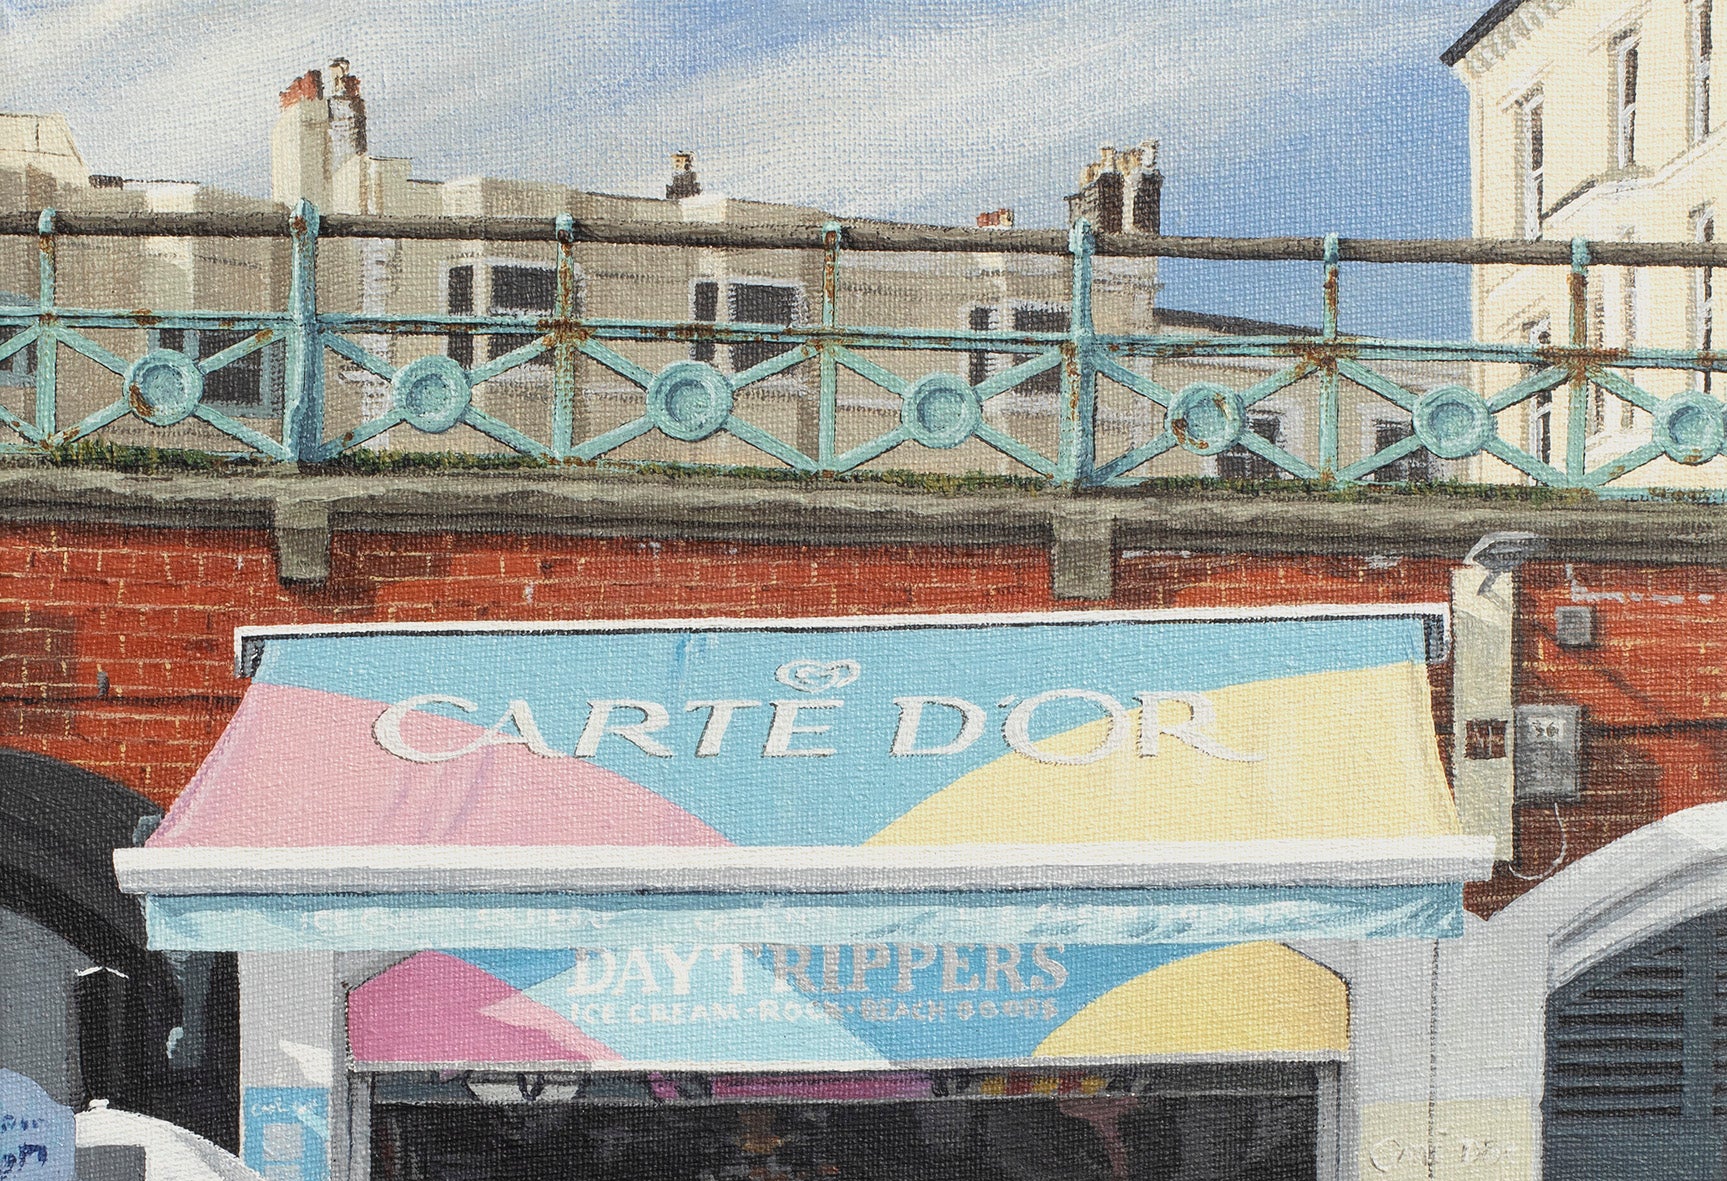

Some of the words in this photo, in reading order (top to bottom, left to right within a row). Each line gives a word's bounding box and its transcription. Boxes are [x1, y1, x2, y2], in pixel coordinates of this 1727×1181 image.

[372, 693, 846, 764] CARTE
[889, 687, 1265, 764] D'OR
[571, 1002, 618, 1025] ICE
[629, 1002, 740, 1025] CREAM
